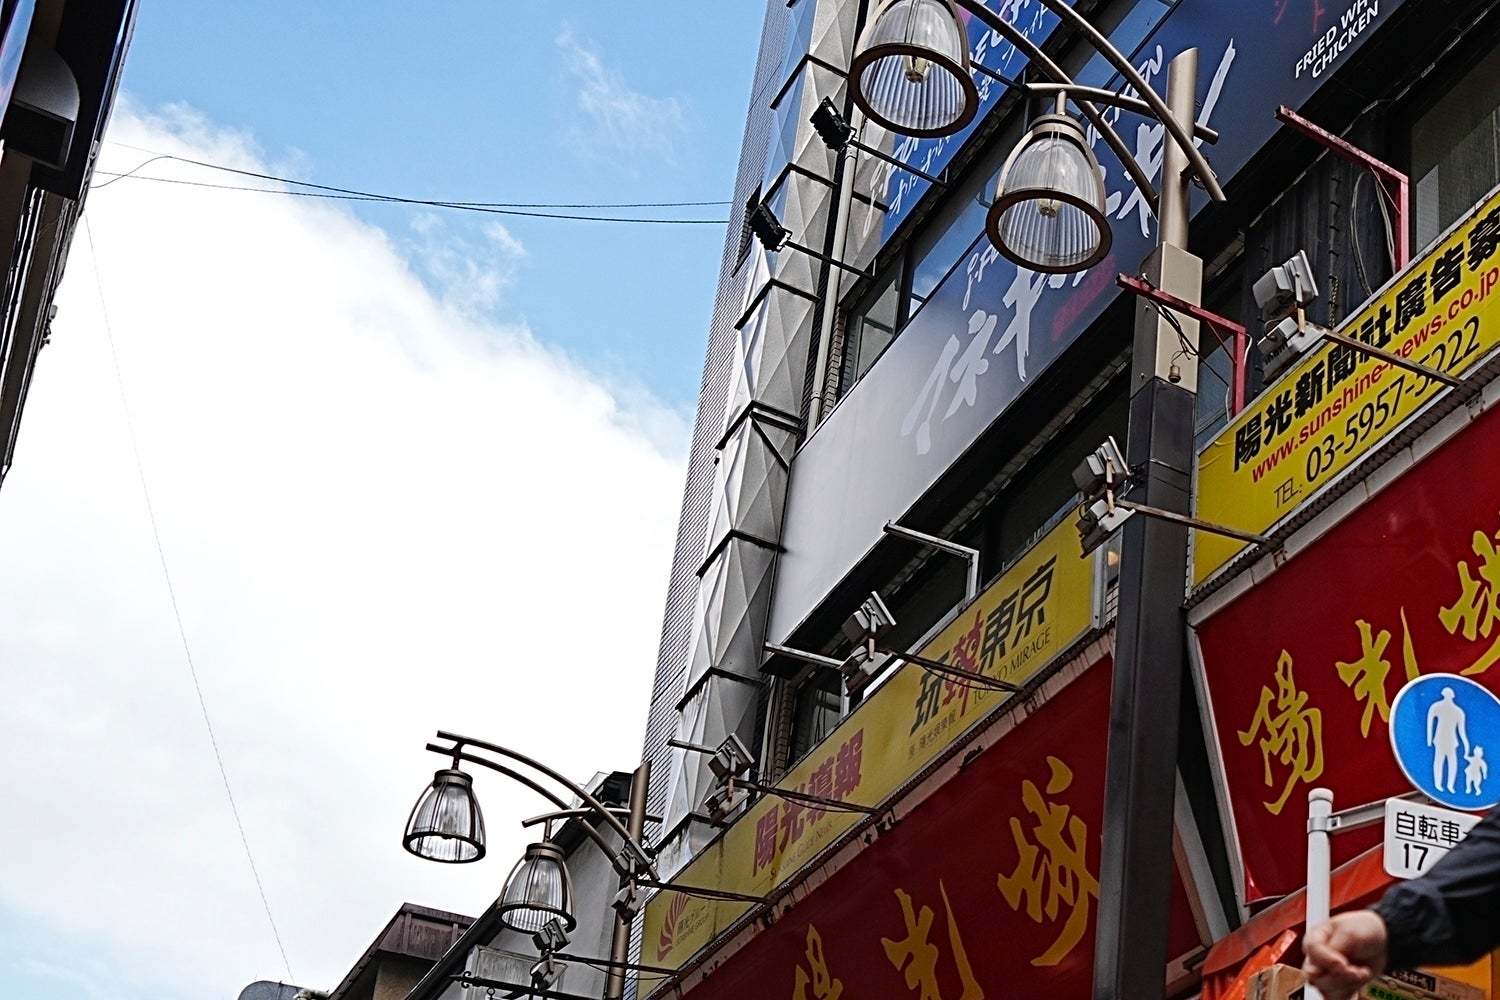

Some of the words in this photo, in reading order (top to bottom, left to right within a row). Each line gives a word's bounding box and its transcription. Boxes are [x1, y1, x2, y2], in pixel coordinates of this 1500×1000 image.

[1295, 25, 1337, 79] FRIED
[1312, 1, 1379, 79] CHICKEN
[1252, 266, 1500, 483] www.sunshine-news.co.jp
[1306, 316, 1480, 483] 03-5957-5222
[1010, 627, 1051, 675] MIRAGE
